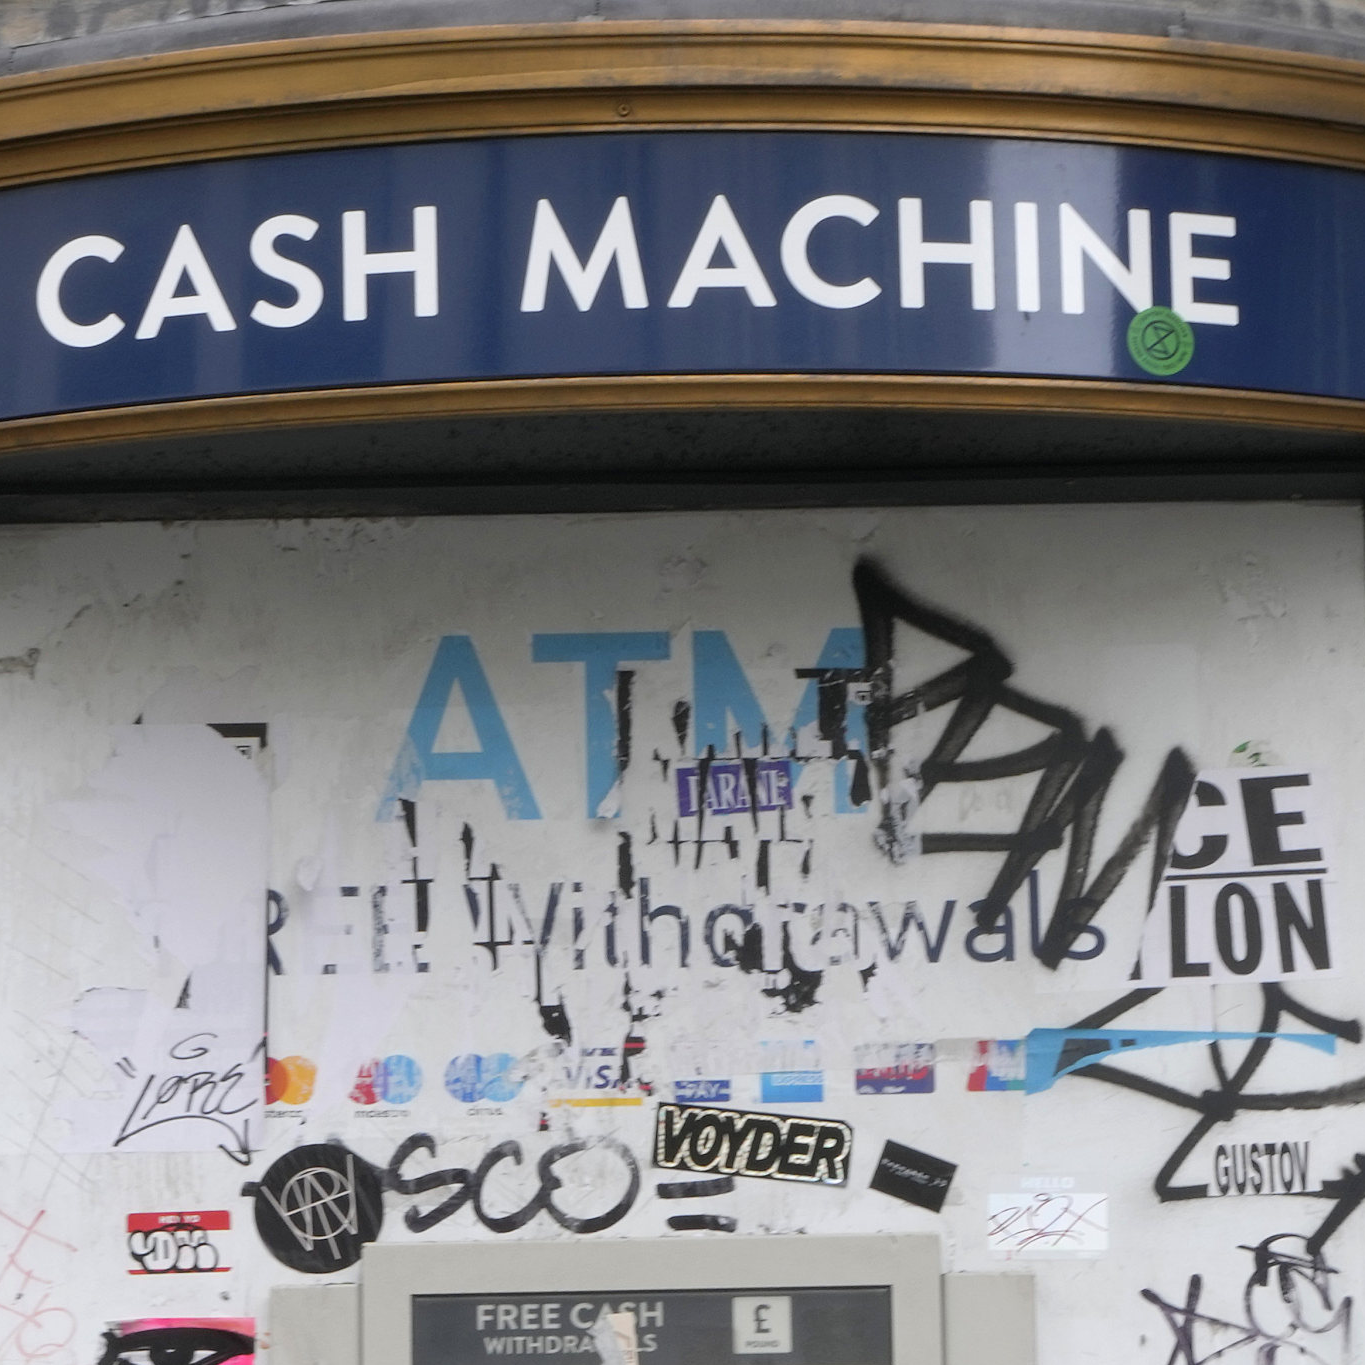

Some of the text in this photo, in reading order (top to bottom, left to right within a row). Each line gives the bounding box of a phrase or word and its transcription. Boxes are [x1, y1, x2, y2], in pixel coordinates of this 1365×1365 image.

[36, 194, 1240, 349] CASH MACHINE
[375, 627, 872, 821] ATM
[659, 1105, 853, 1185] VOYDER
[1216, 1141, 1310, 1195] GUSTOV
[475, 1303, 562, 1331] FREE
